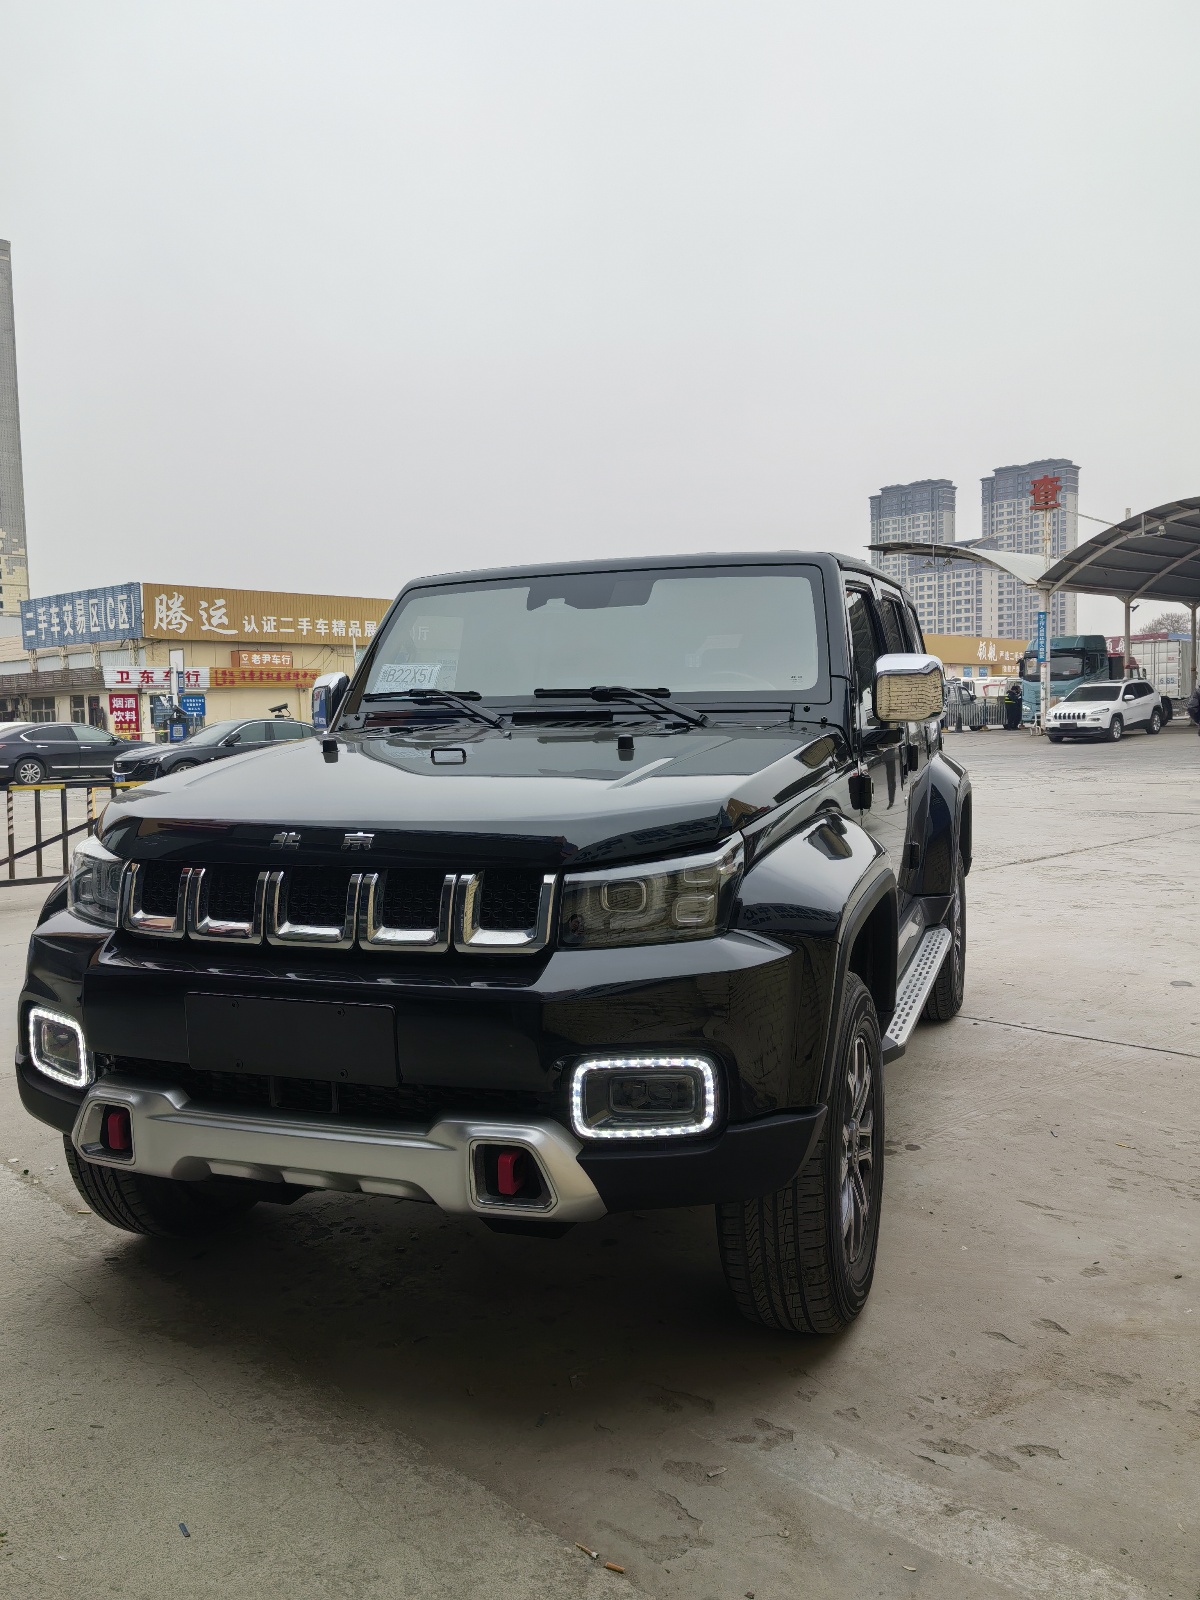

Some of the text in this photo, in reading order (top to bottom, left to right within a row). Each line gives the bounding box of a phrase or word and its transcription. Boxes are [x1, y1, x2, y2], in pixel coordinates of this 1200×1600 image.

[25, 594, 135, 641] 二手车交易区(C区)
[153, 592, 238, 635] 腾运
[251, 653, 291, 665] 老尹车行
[111, 696, 136, 709] 烟酒
[113, 711, 137, 722] 饮料
[270, 831, 375, 851] 北京
